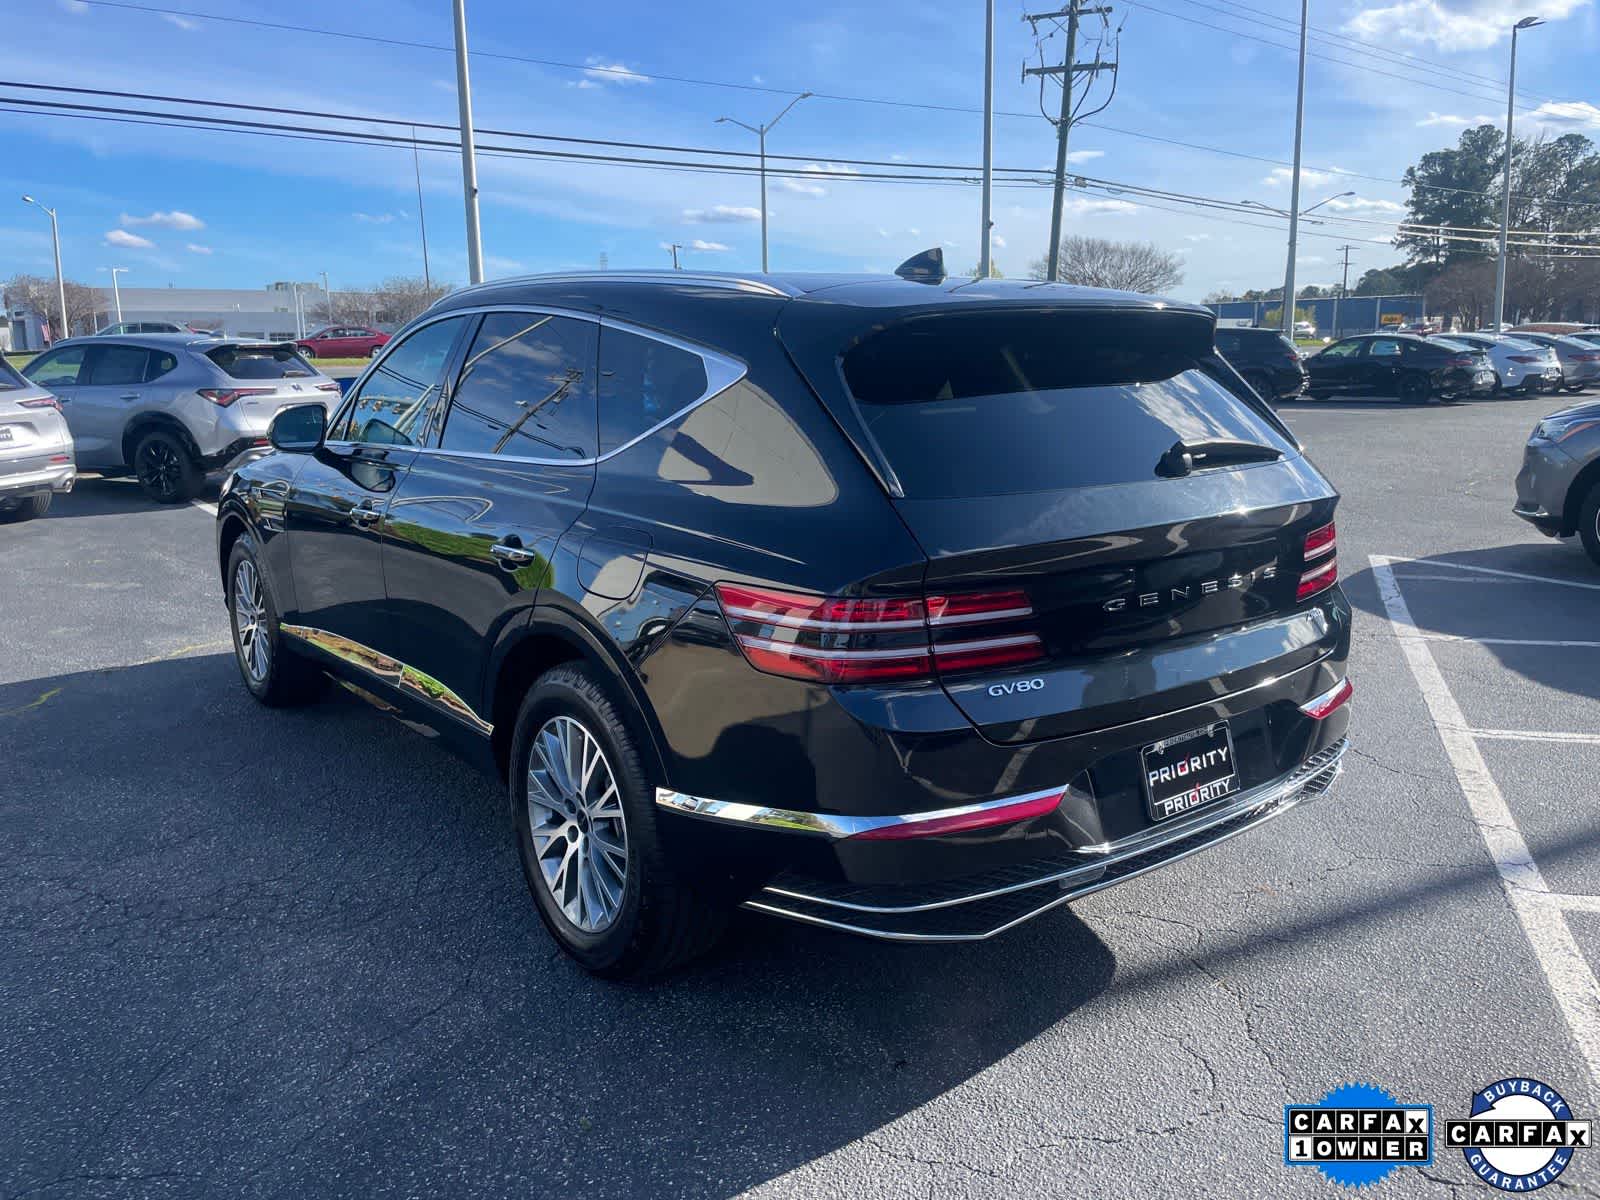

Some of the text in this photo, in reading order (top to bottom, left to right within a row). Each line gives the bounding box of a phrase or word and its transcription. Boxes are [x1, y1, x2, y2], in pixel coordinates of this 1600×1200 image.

[1102, 566, 1277, 612] GENESIS
[988, 678, 1045, 697] GV80
[1148, 746, 1228, 787] PRIORITY
[1164, 778, 1231, 815] PRIORITY
